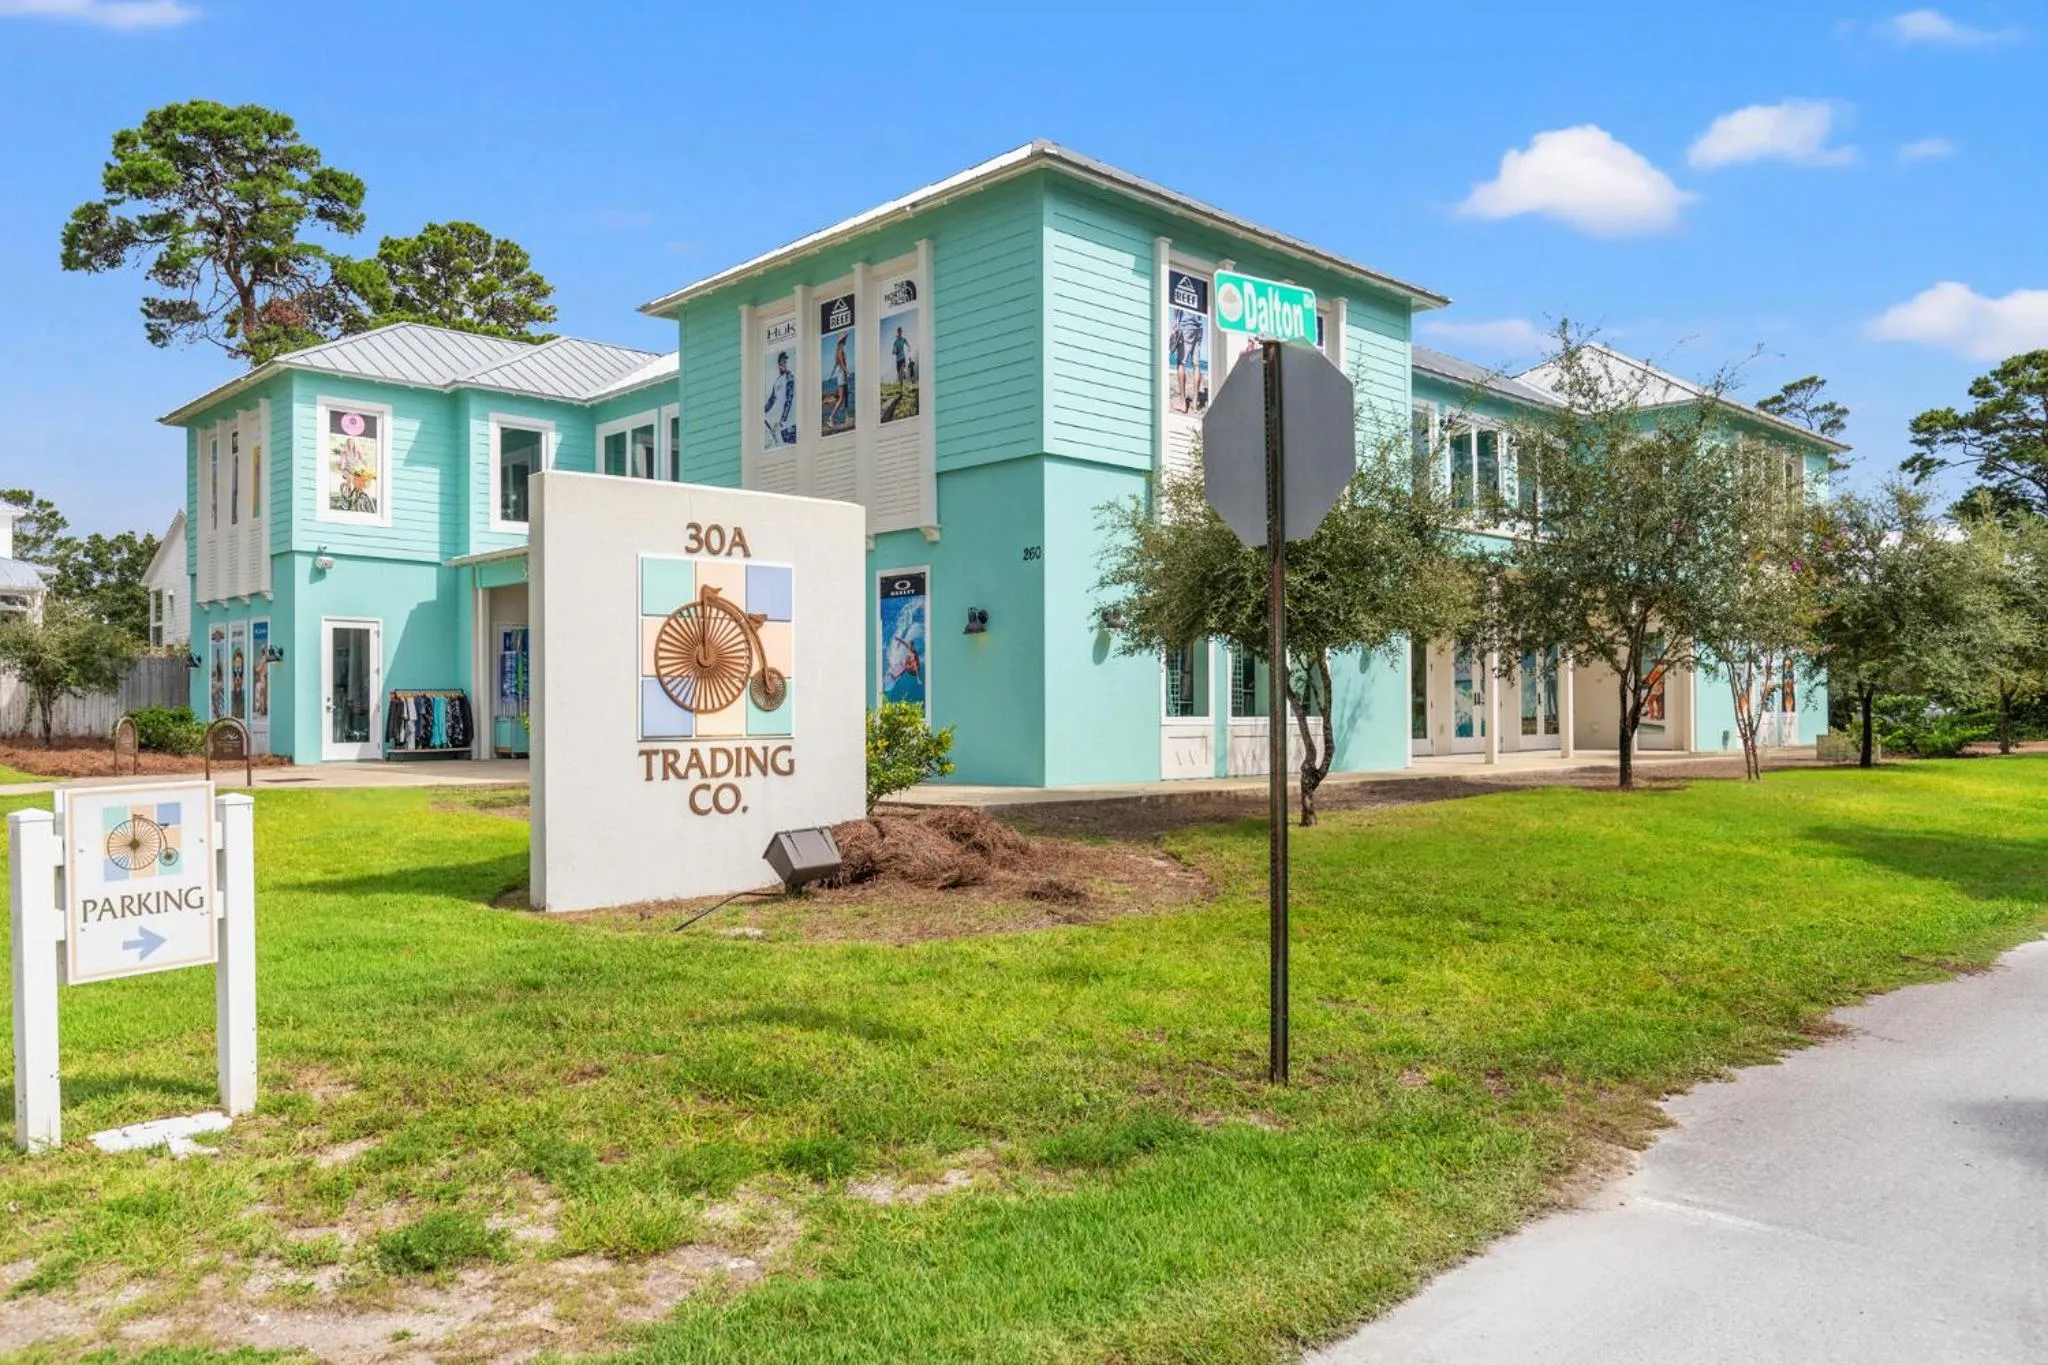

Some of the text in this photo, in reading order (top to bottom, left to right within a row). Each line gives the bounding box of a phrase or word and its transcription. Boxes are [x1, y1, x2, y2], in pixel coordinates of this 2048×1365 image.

[1176, 290, 1197, 306] REEF
[1243, 281, 1304, 337] Dalton
[831, 312, 850, 328] REEF
[684, 522, 751, 557] 30A
[1023, 546, 1041, 561] 260
[638, 745, 795, 781] TRADING
[689, 782, 749, 816] CO.
[82, 886, 204, 923] PARKING
